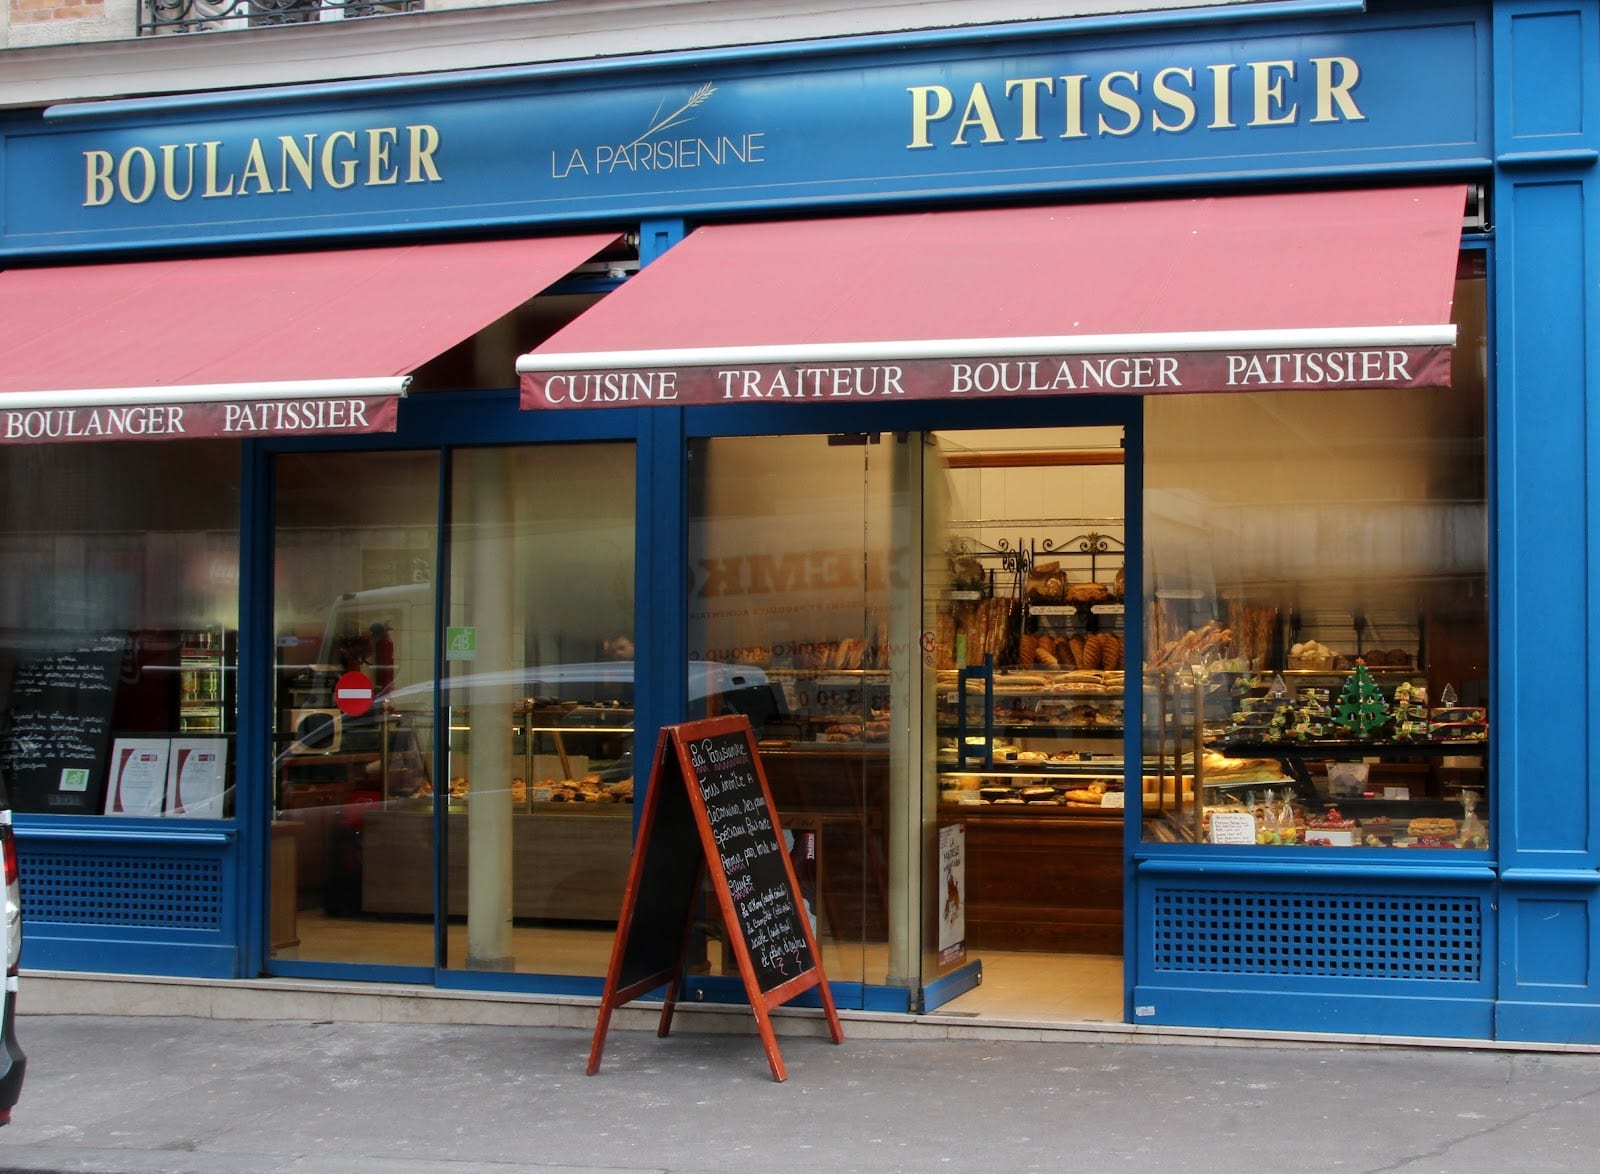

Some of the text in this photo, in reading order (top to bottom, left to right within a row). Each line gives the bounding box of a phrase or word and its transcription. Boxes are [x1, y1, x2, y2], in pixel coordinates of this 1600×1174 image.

[906, 57, 1366, 149] PATISSIER
[82, 124, 442, 207] BOULANGER
[550, 132, 766, 180] LA PARISIENNE
[544, 349, 1413, 404] CUISINE TRAITEUR BOULANGER PATISSIER
[4, 399, 369, 438] BOULANGER PATISSIER
[690, 738, 747, 768] La Parisienne
